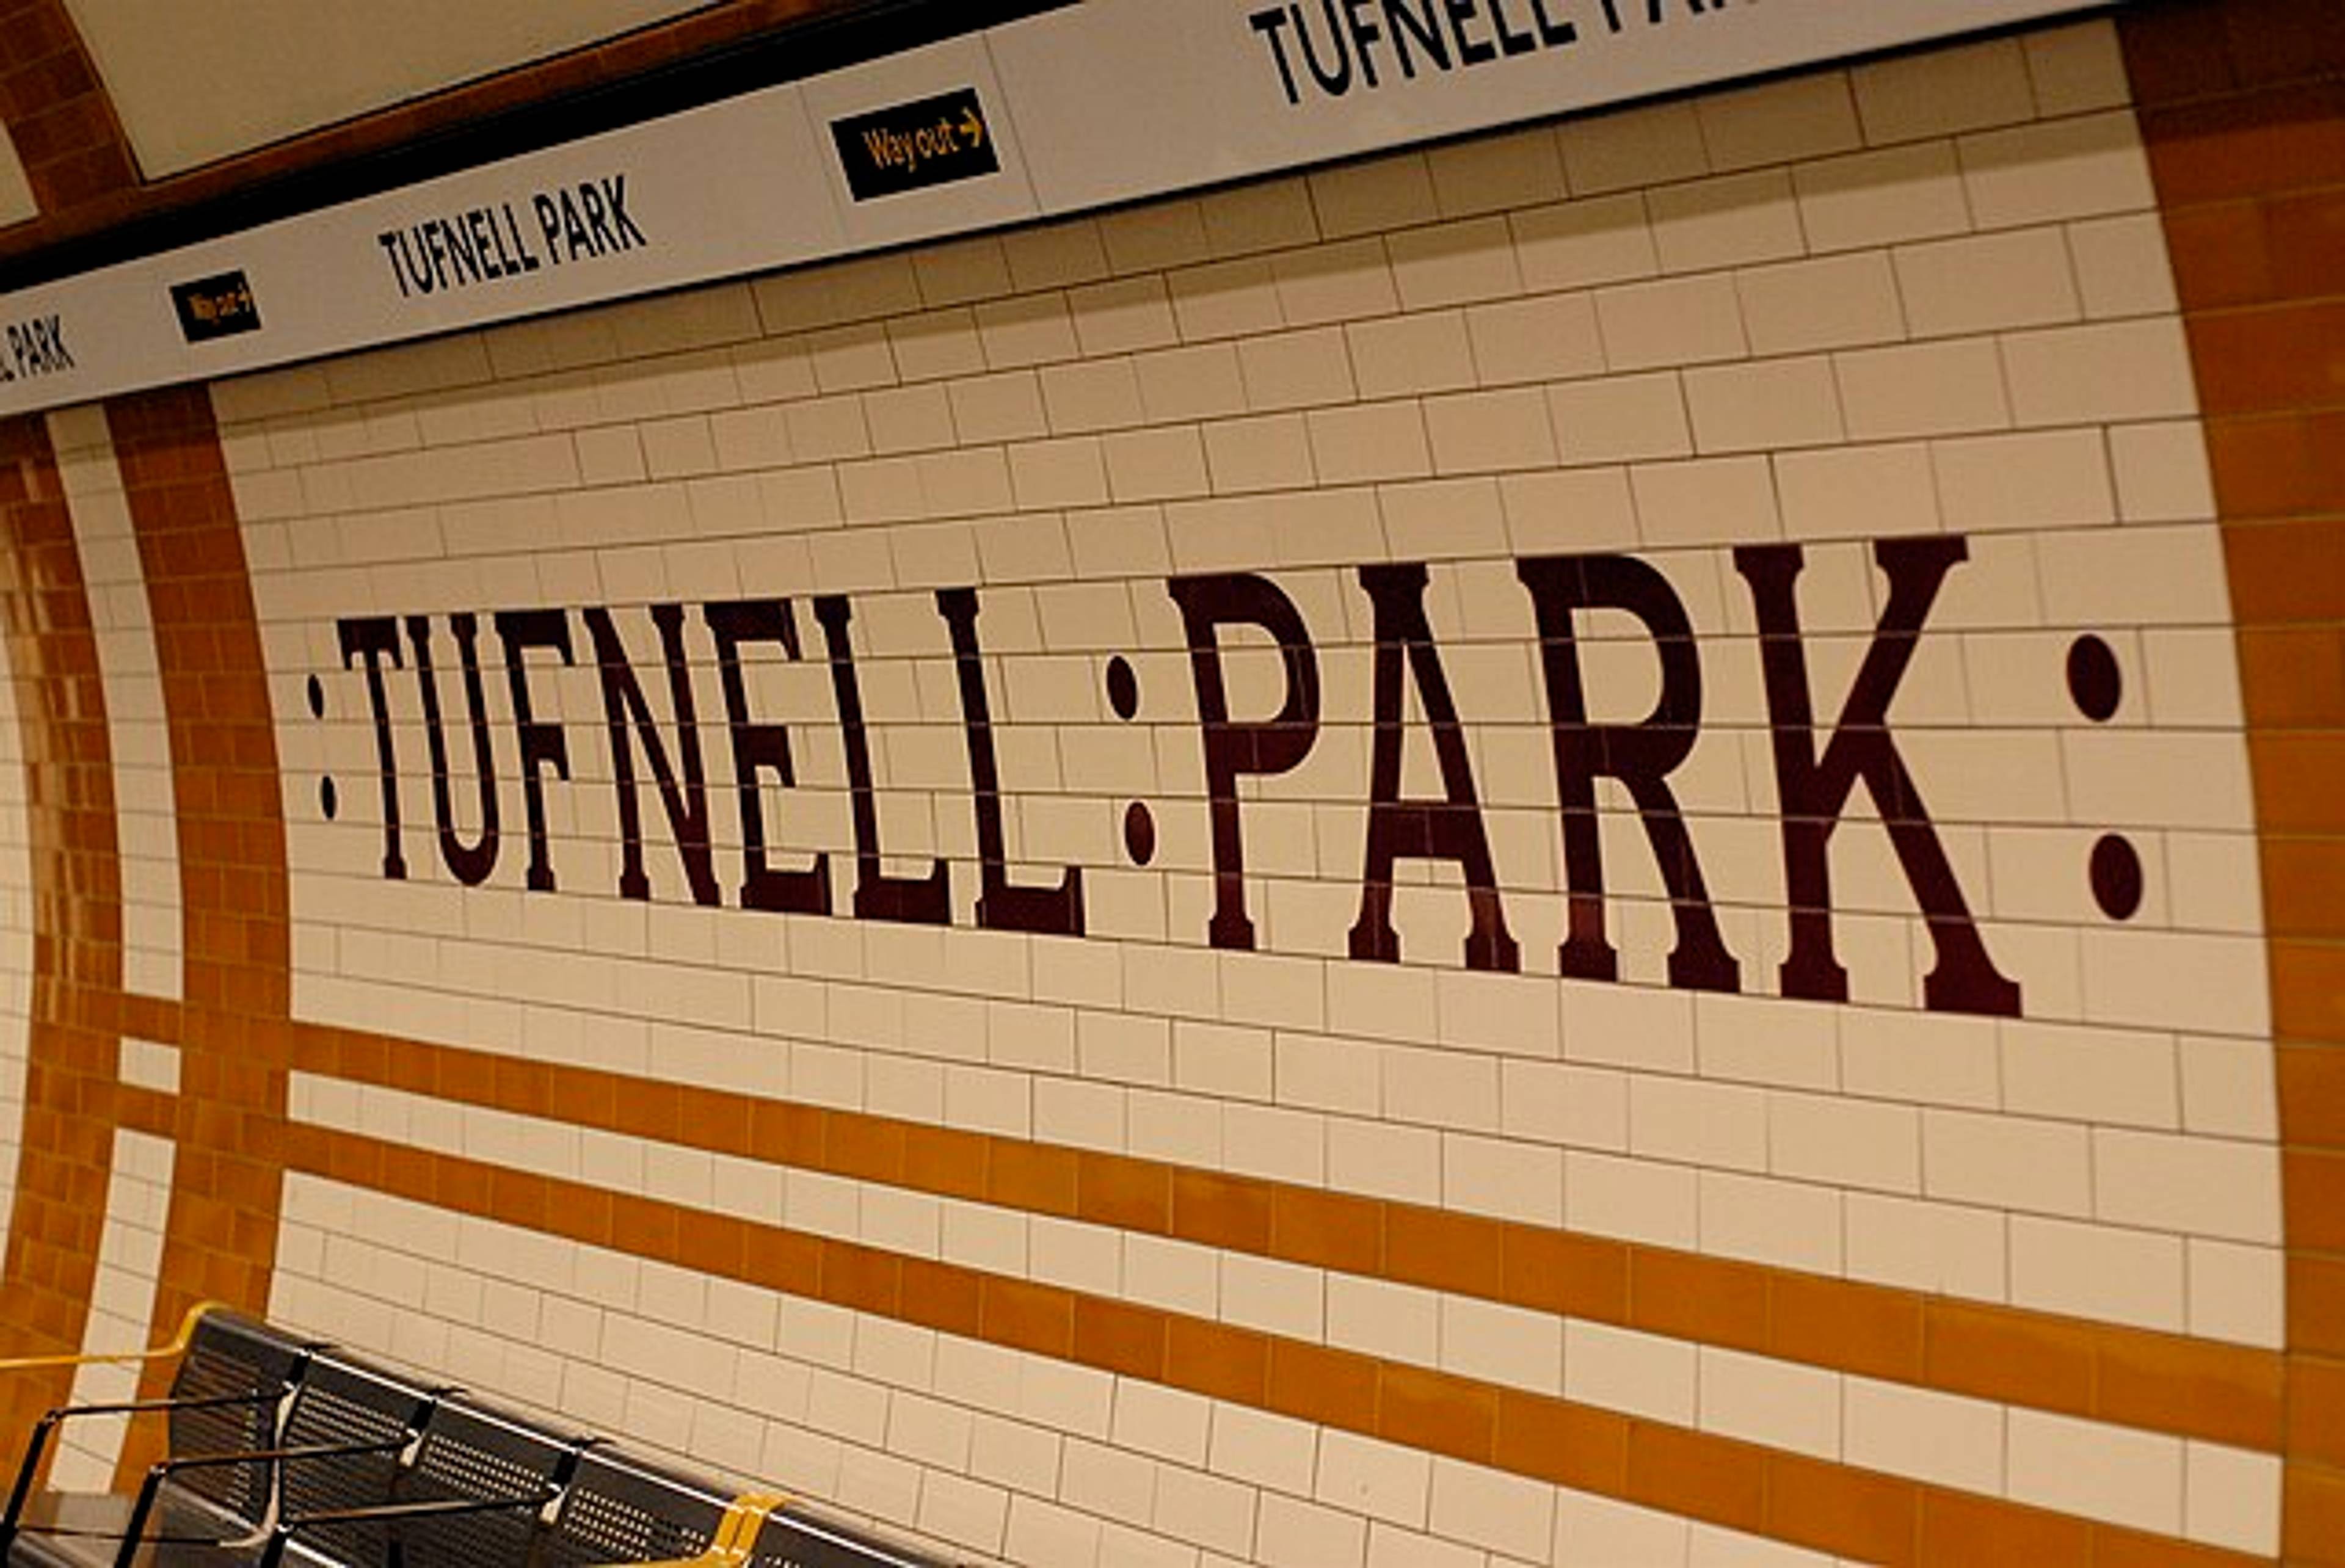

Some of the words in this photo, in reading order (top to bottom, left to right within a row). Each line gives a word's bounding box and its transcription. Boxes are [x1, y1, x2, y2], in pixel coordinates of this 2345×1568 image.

[861, 127, 916, 173] Way
[916, 117, 960, 159] out
[377, 203, 540, 297] TUFNELL
[533, 174, 647, 265] PARK
[7, 314, 75, 379] PARK
